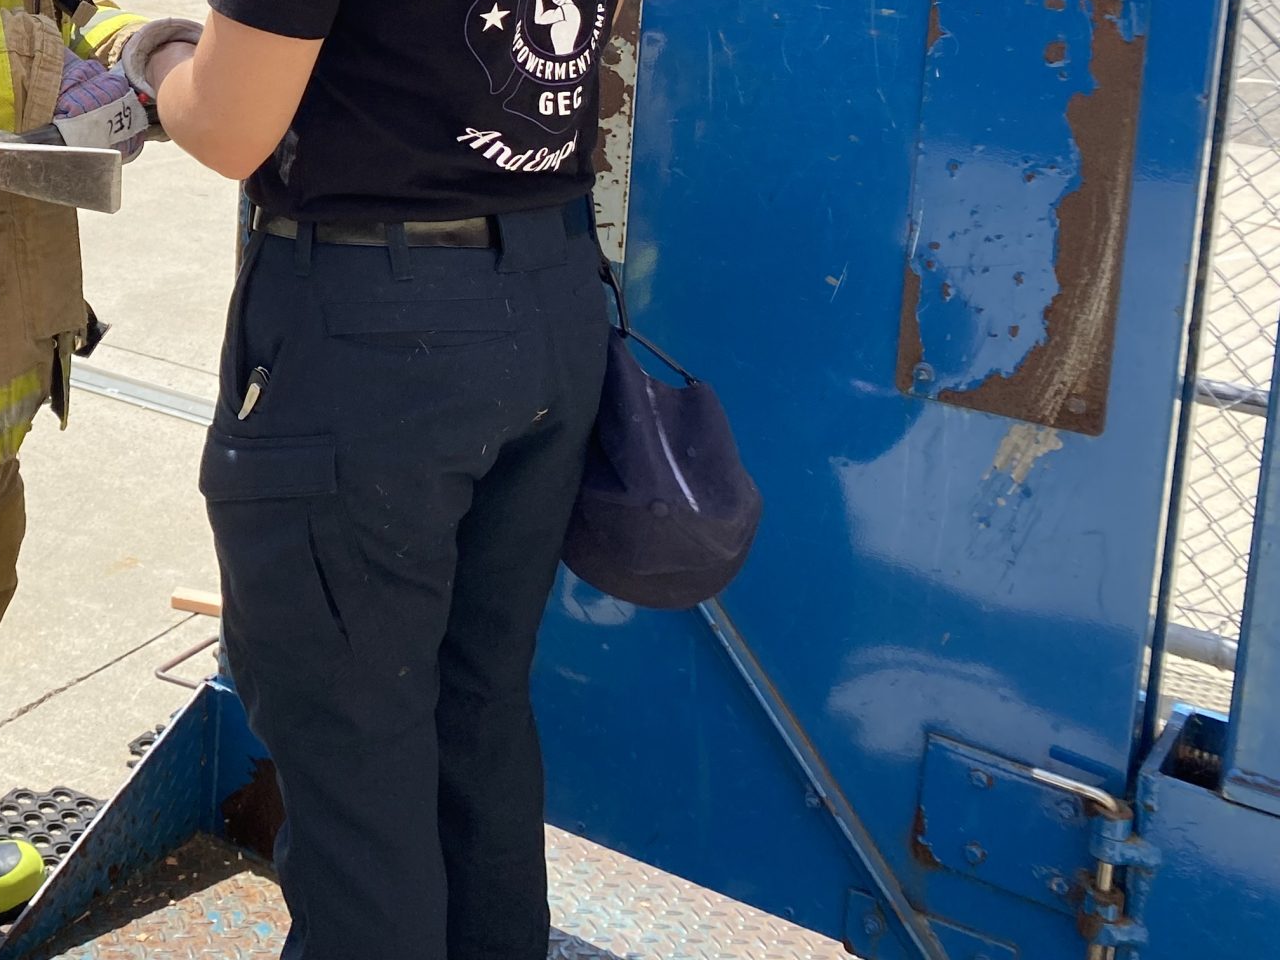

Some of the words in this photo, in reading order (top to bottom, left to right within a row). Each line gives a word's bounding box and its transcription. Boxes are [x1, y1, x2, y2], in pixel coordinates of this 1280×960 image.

[590, 3, 605, 51] CAMP
[538, 85, 582, 116] GEC
[456, 127, 534, 171] And
